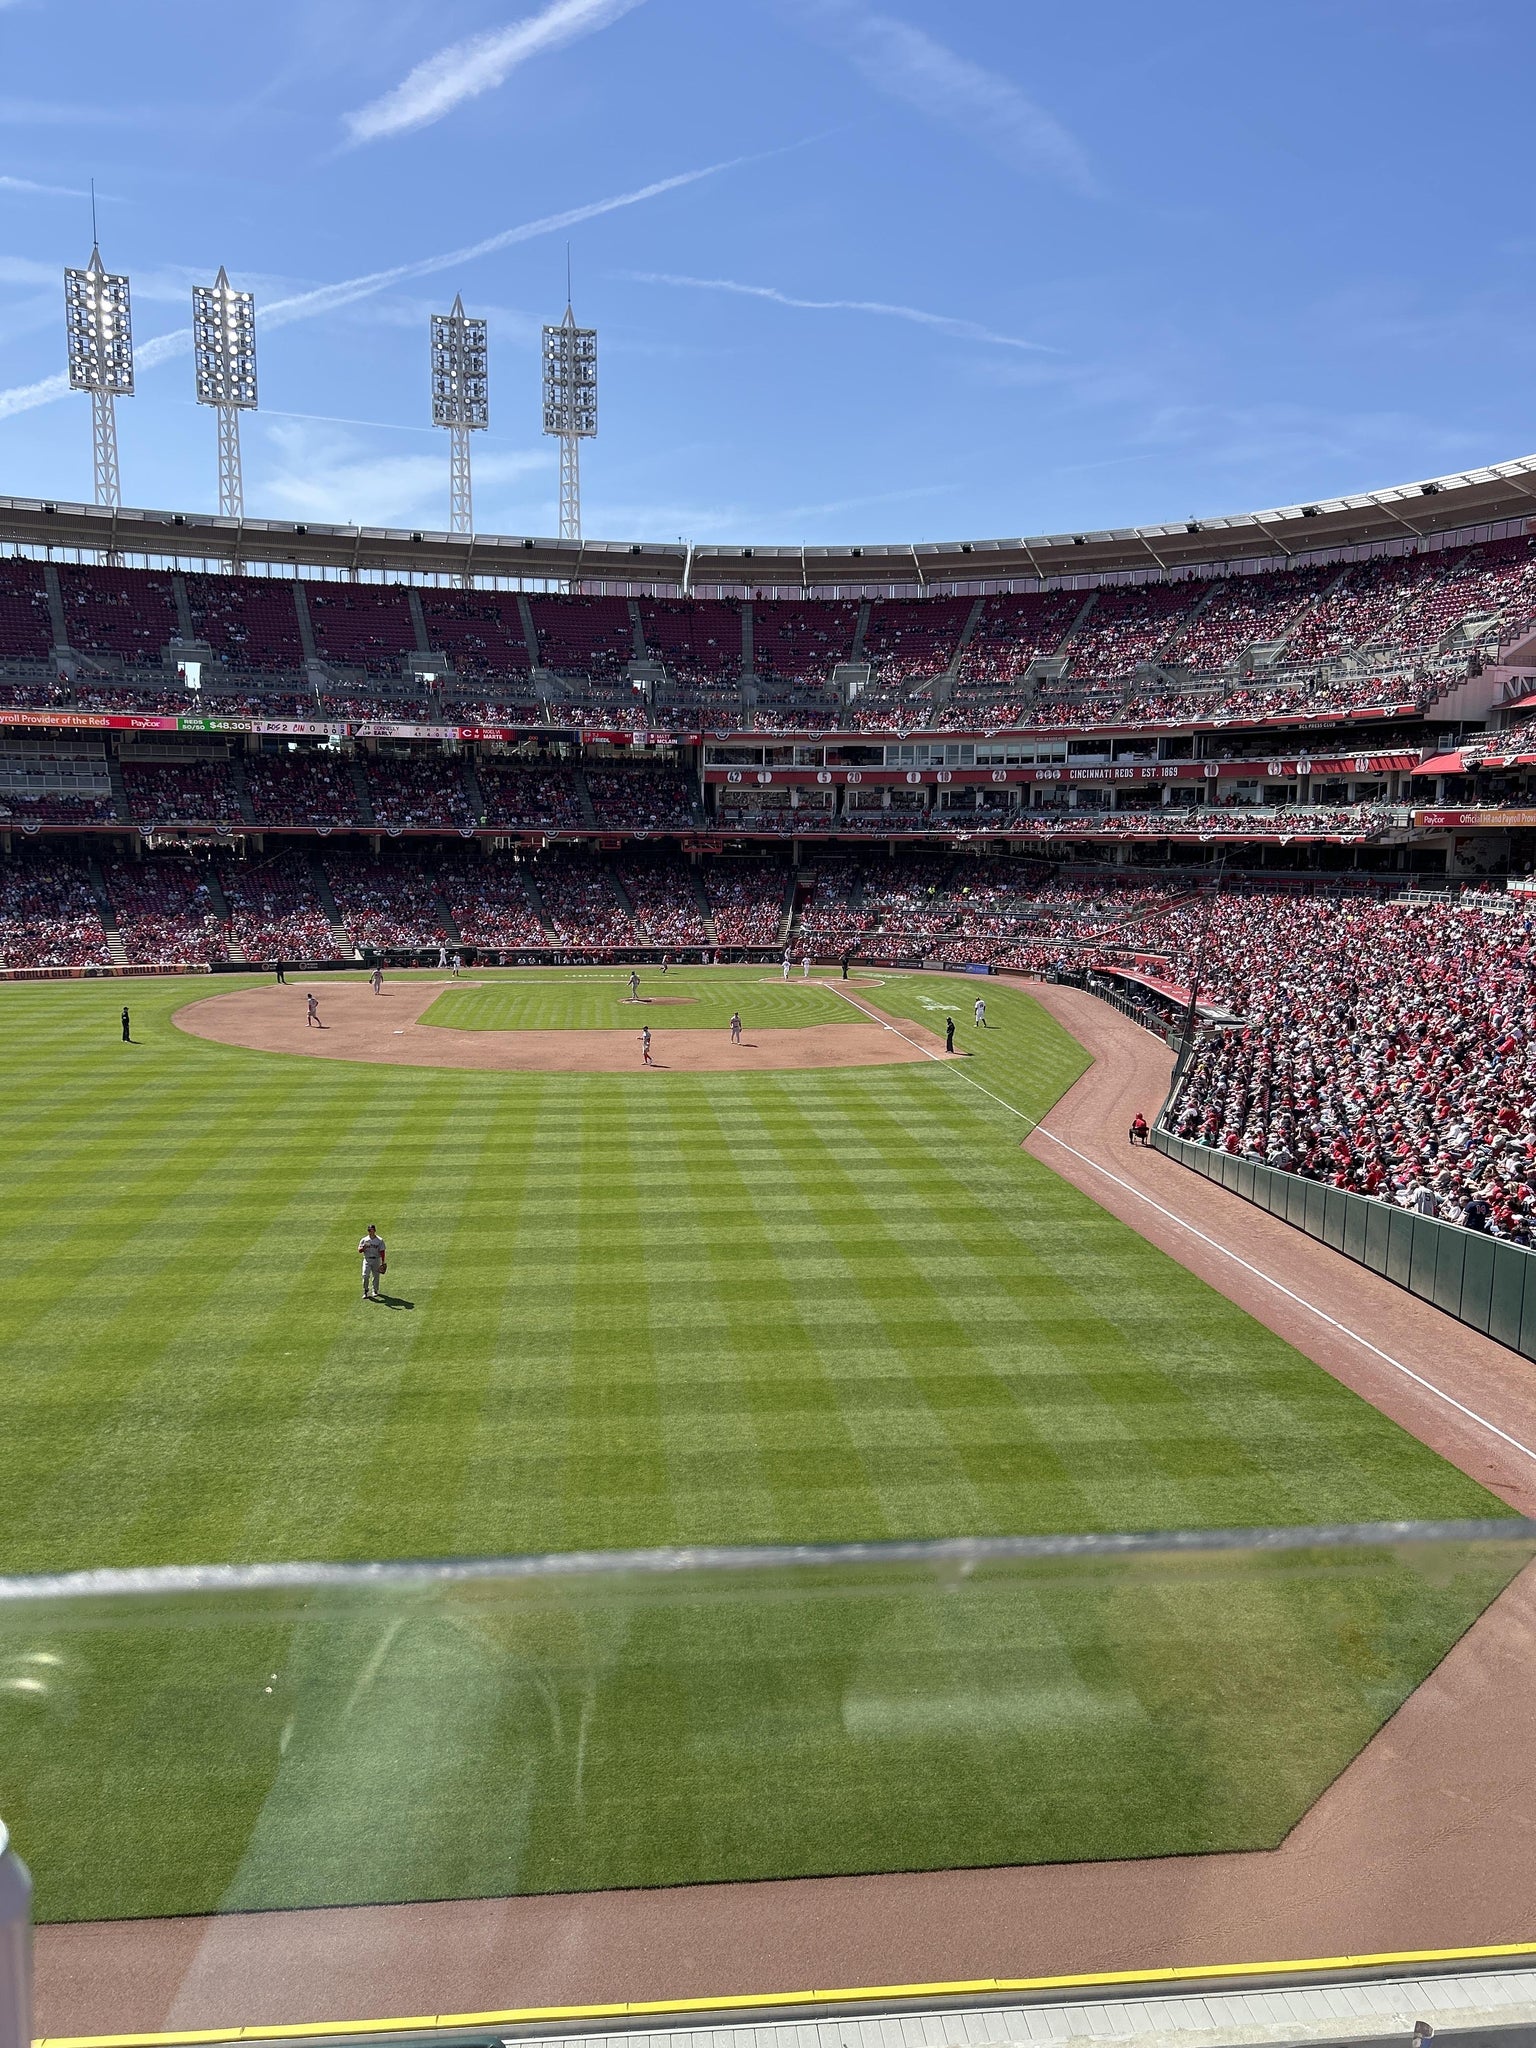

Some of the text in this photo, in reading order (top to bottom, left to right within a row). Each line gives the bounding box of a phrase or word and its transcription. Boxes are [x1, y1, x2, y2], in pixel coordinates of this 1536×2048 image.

[22, 715, 59, 724] Provider
[62, 716, 71, 725] of
[73, 717, 88, 725] the
[89, 717, 110, 726] Reds
[131, 718, 160, 728] Paycor
[210, 720, 251, 730] $48,305
[267, 723, 316, 733] BOS 2 CIN 0
[1069, 767, 1178, 779] CINCINNATI REDS EST. 1869
[1205, 764, 1217, 777] 10
[729, 772, 740, 782] 42
[821, 772, 828, 782] 5
[848, 772, 860, 782] 20
[940, 771, 950, 782] 18
[1423, 814, 1445, 825] Paycor
[1459, 814, 1482, 824] Official
[1491, 814, 1501, 823] and
[1502, 813, 1521, 824] Payroll
[14, 969, 73, 979] GORILLA GLUE
[122, 967, 157, 975] GORILLA
[1424, 1192, 1431, 1202] 5
